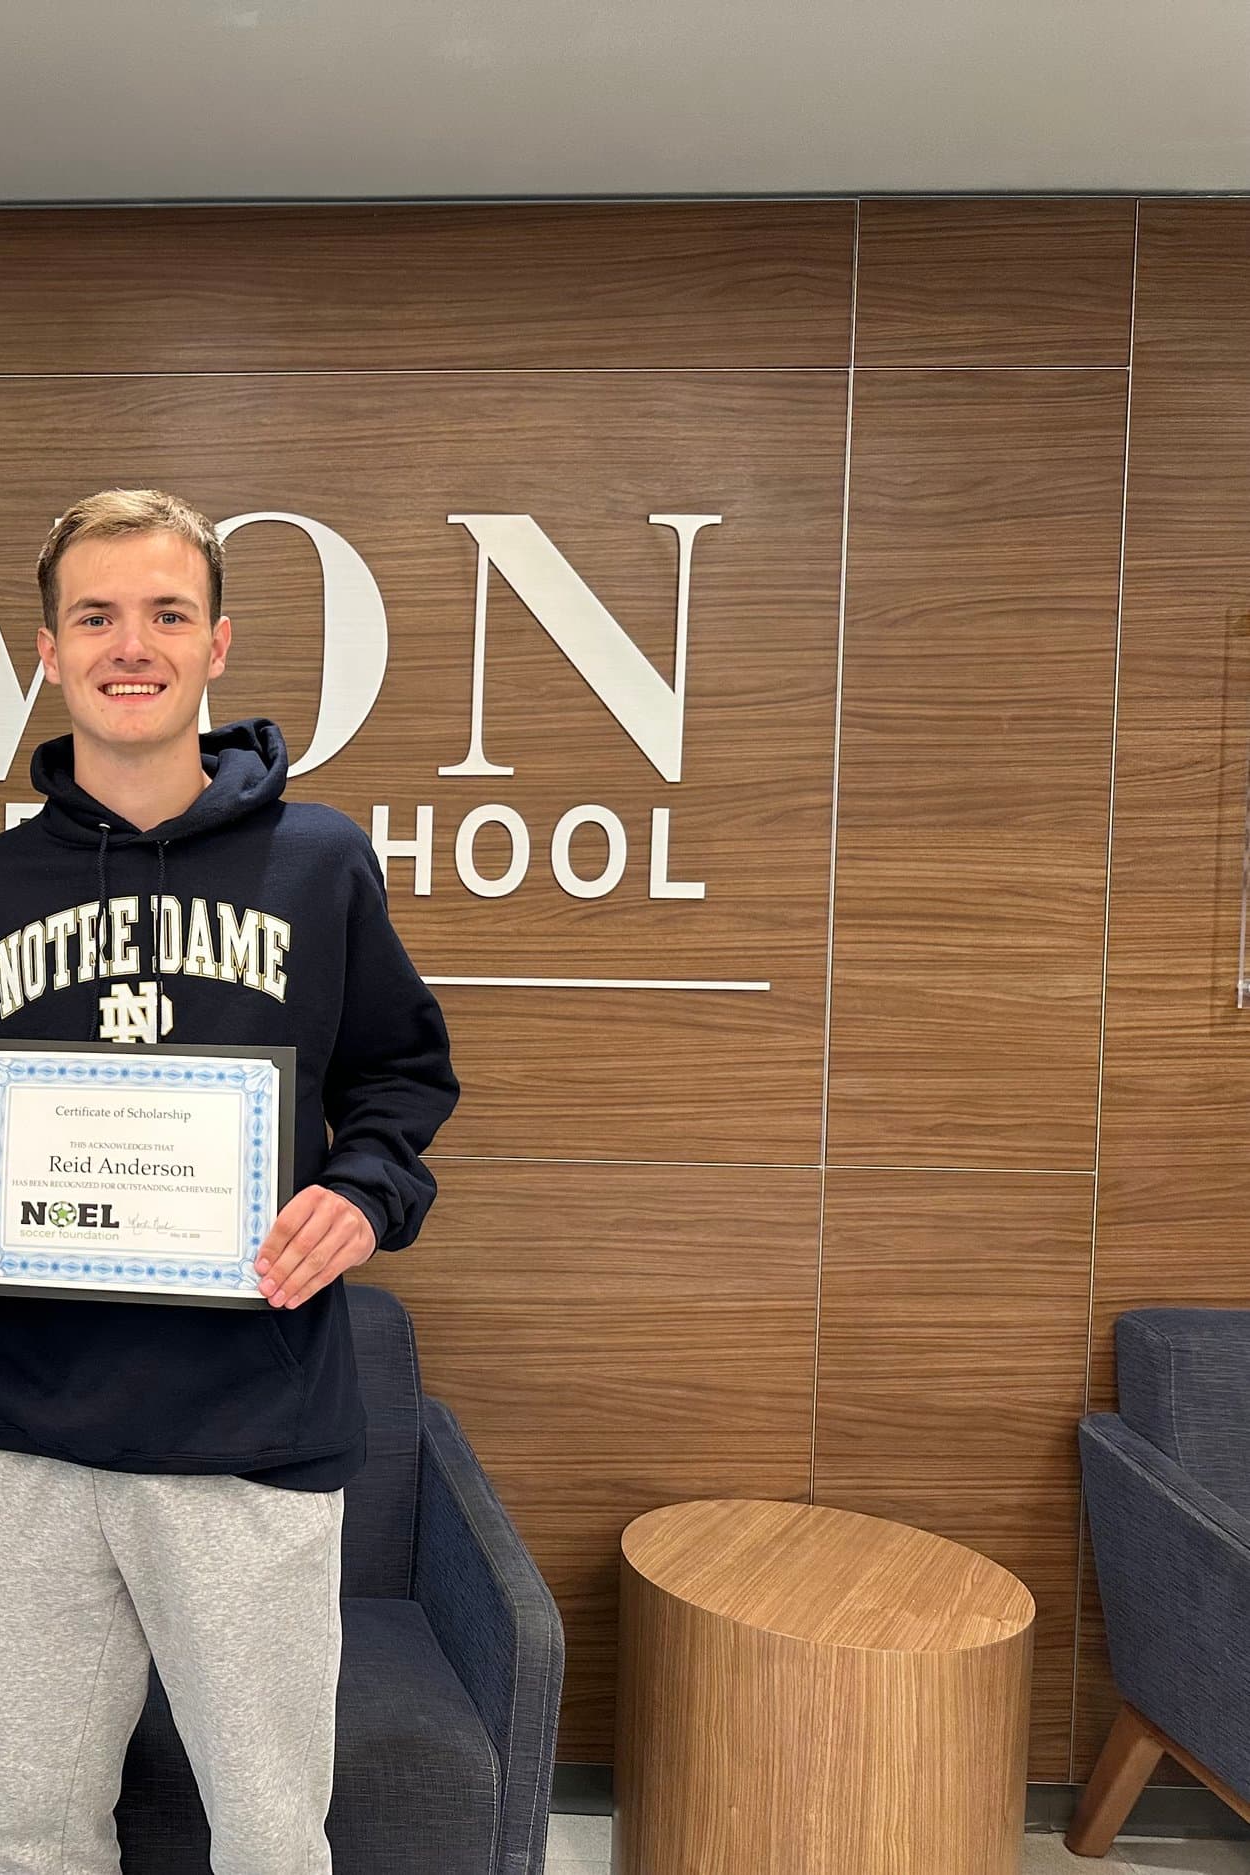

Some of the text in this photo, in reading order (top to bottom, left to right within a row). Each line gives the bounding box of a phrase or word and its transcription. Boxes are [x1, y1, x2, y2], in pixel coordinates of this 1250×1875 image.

[372, 803, 706, 899] HOOL
[151, 895, 292, 1004] DAME
[55, 1105, 192, 1123] Certificate of Scholarship
[70, 1141, 175, 1152] THIS ACKNOWLEDGES THAT
[49, 1155, 196, 1178] Reid Anderson
[12, 1179, 233, 1195] HAS BEEN RECOGNIZED FOR OUTSTANDING ACHIEVEMENT
[20, 1228, 120, 1241] soccer foundation
